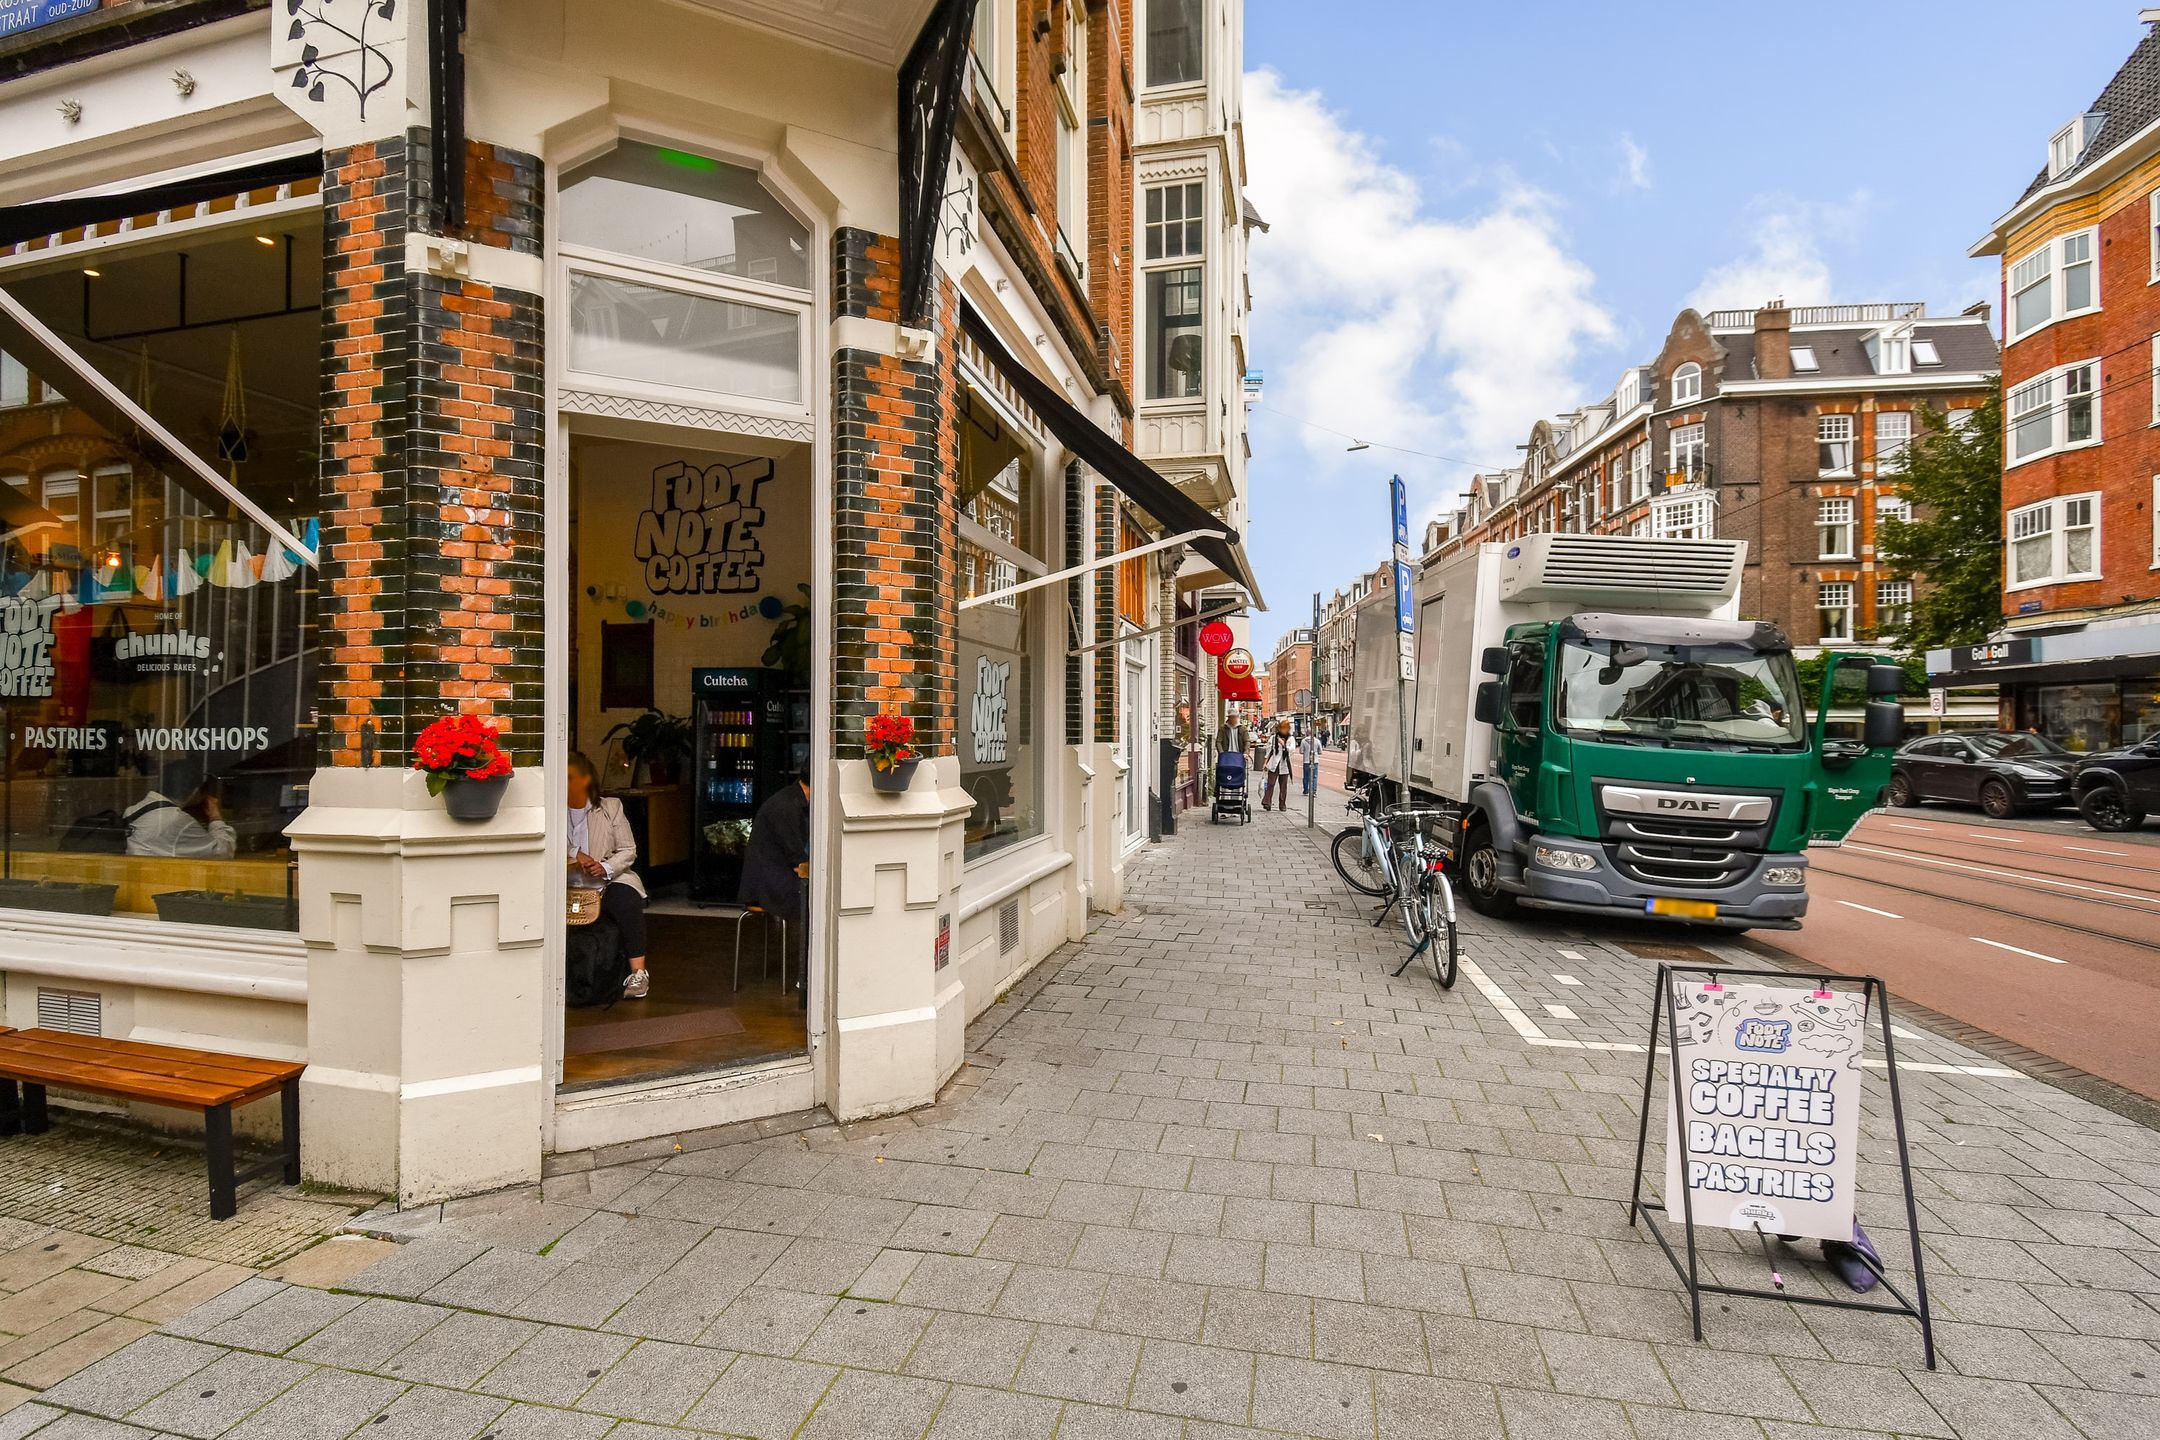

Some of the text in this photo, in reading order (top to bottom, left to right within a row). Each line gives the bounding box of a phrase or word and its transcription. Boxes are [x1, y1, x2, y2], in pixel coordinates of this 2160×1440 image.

[0, 5, 38, 31] TRAAT
[651, 457, 774, 514] FOOT
[635, 499, 765, 562] NOTE
[645, 550, 765, 595] COFFEE
[1401, 569, 1410, 602] P
[154, 612, 172, 620] HOME
[115, 629, 210, 660] chunks
[1202, 633, 1231, 643] WOW
[0, 666, 56, 697] OFFEE
[137, 663, 197, 672] DELICIOUS BAKES
[703, 675, 748, 686] Cultcha
[976, 654, 1010, 699] FOOT
[971, 692, 1008, 736] NOTE
[25, 726, 269, 751] PASTRIES WORKSHOPS
[1657, 798, 1720, 811] DAF
[1741, 1033, 1784, 1049] NOTE
[1745, 1021, 1788, 1036] FOOT
[1691, 1058, 1837, 1092] SPECIALTY
[1690, 1080, 1835, 1126] COFFEE
[1689, 1120, 1836, 1166] BAGELS
[1688, 1160, 1834, 1202] PASTRIES
